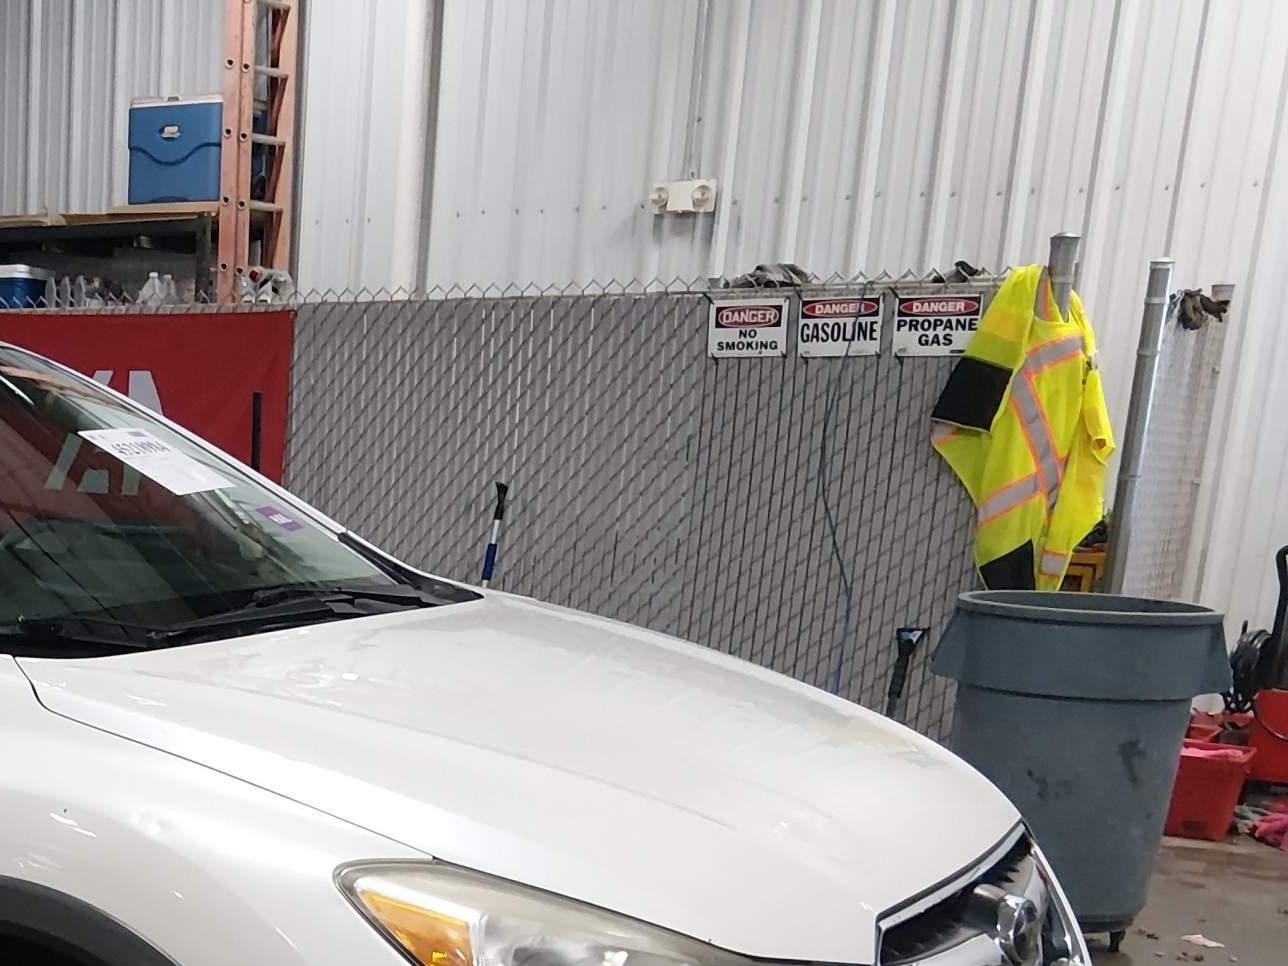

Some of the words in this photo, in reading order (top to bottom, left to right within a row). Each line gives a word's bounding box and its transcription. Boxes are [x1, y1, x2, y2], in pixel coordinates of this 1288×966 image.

[912, 301, 965, 313] DANGER
[723, 308, 776, 324] DANGER
[897, 317, 978, 331] PROPANE
[738, 329, 757, 338] NO
[801, 321, 878, 342] GASOLINE
[717, 340, 778, 352] SMOKING
[918, 334, 954, 346] GAS
